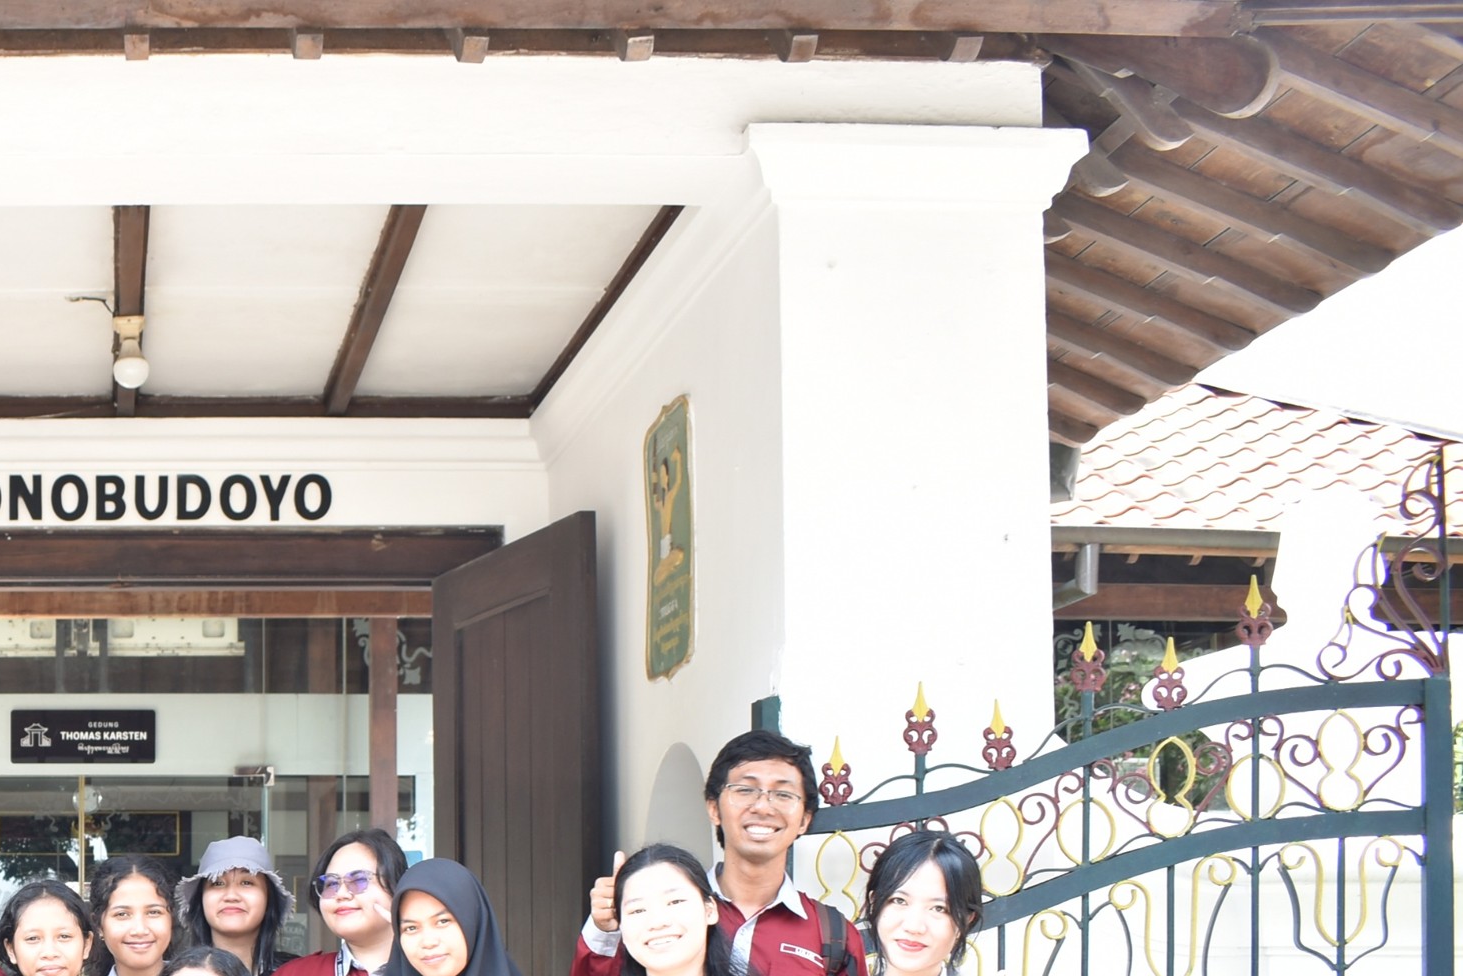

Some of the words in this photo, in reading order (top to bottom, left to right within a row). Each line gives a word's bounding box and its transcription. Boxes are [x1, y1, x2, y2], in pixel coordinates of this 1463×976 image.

[87, 721, 120, 729] GEDUNG
[60, 731, 102, 741] THOMAS
[103, 731, 148, 741] KARSTEN
